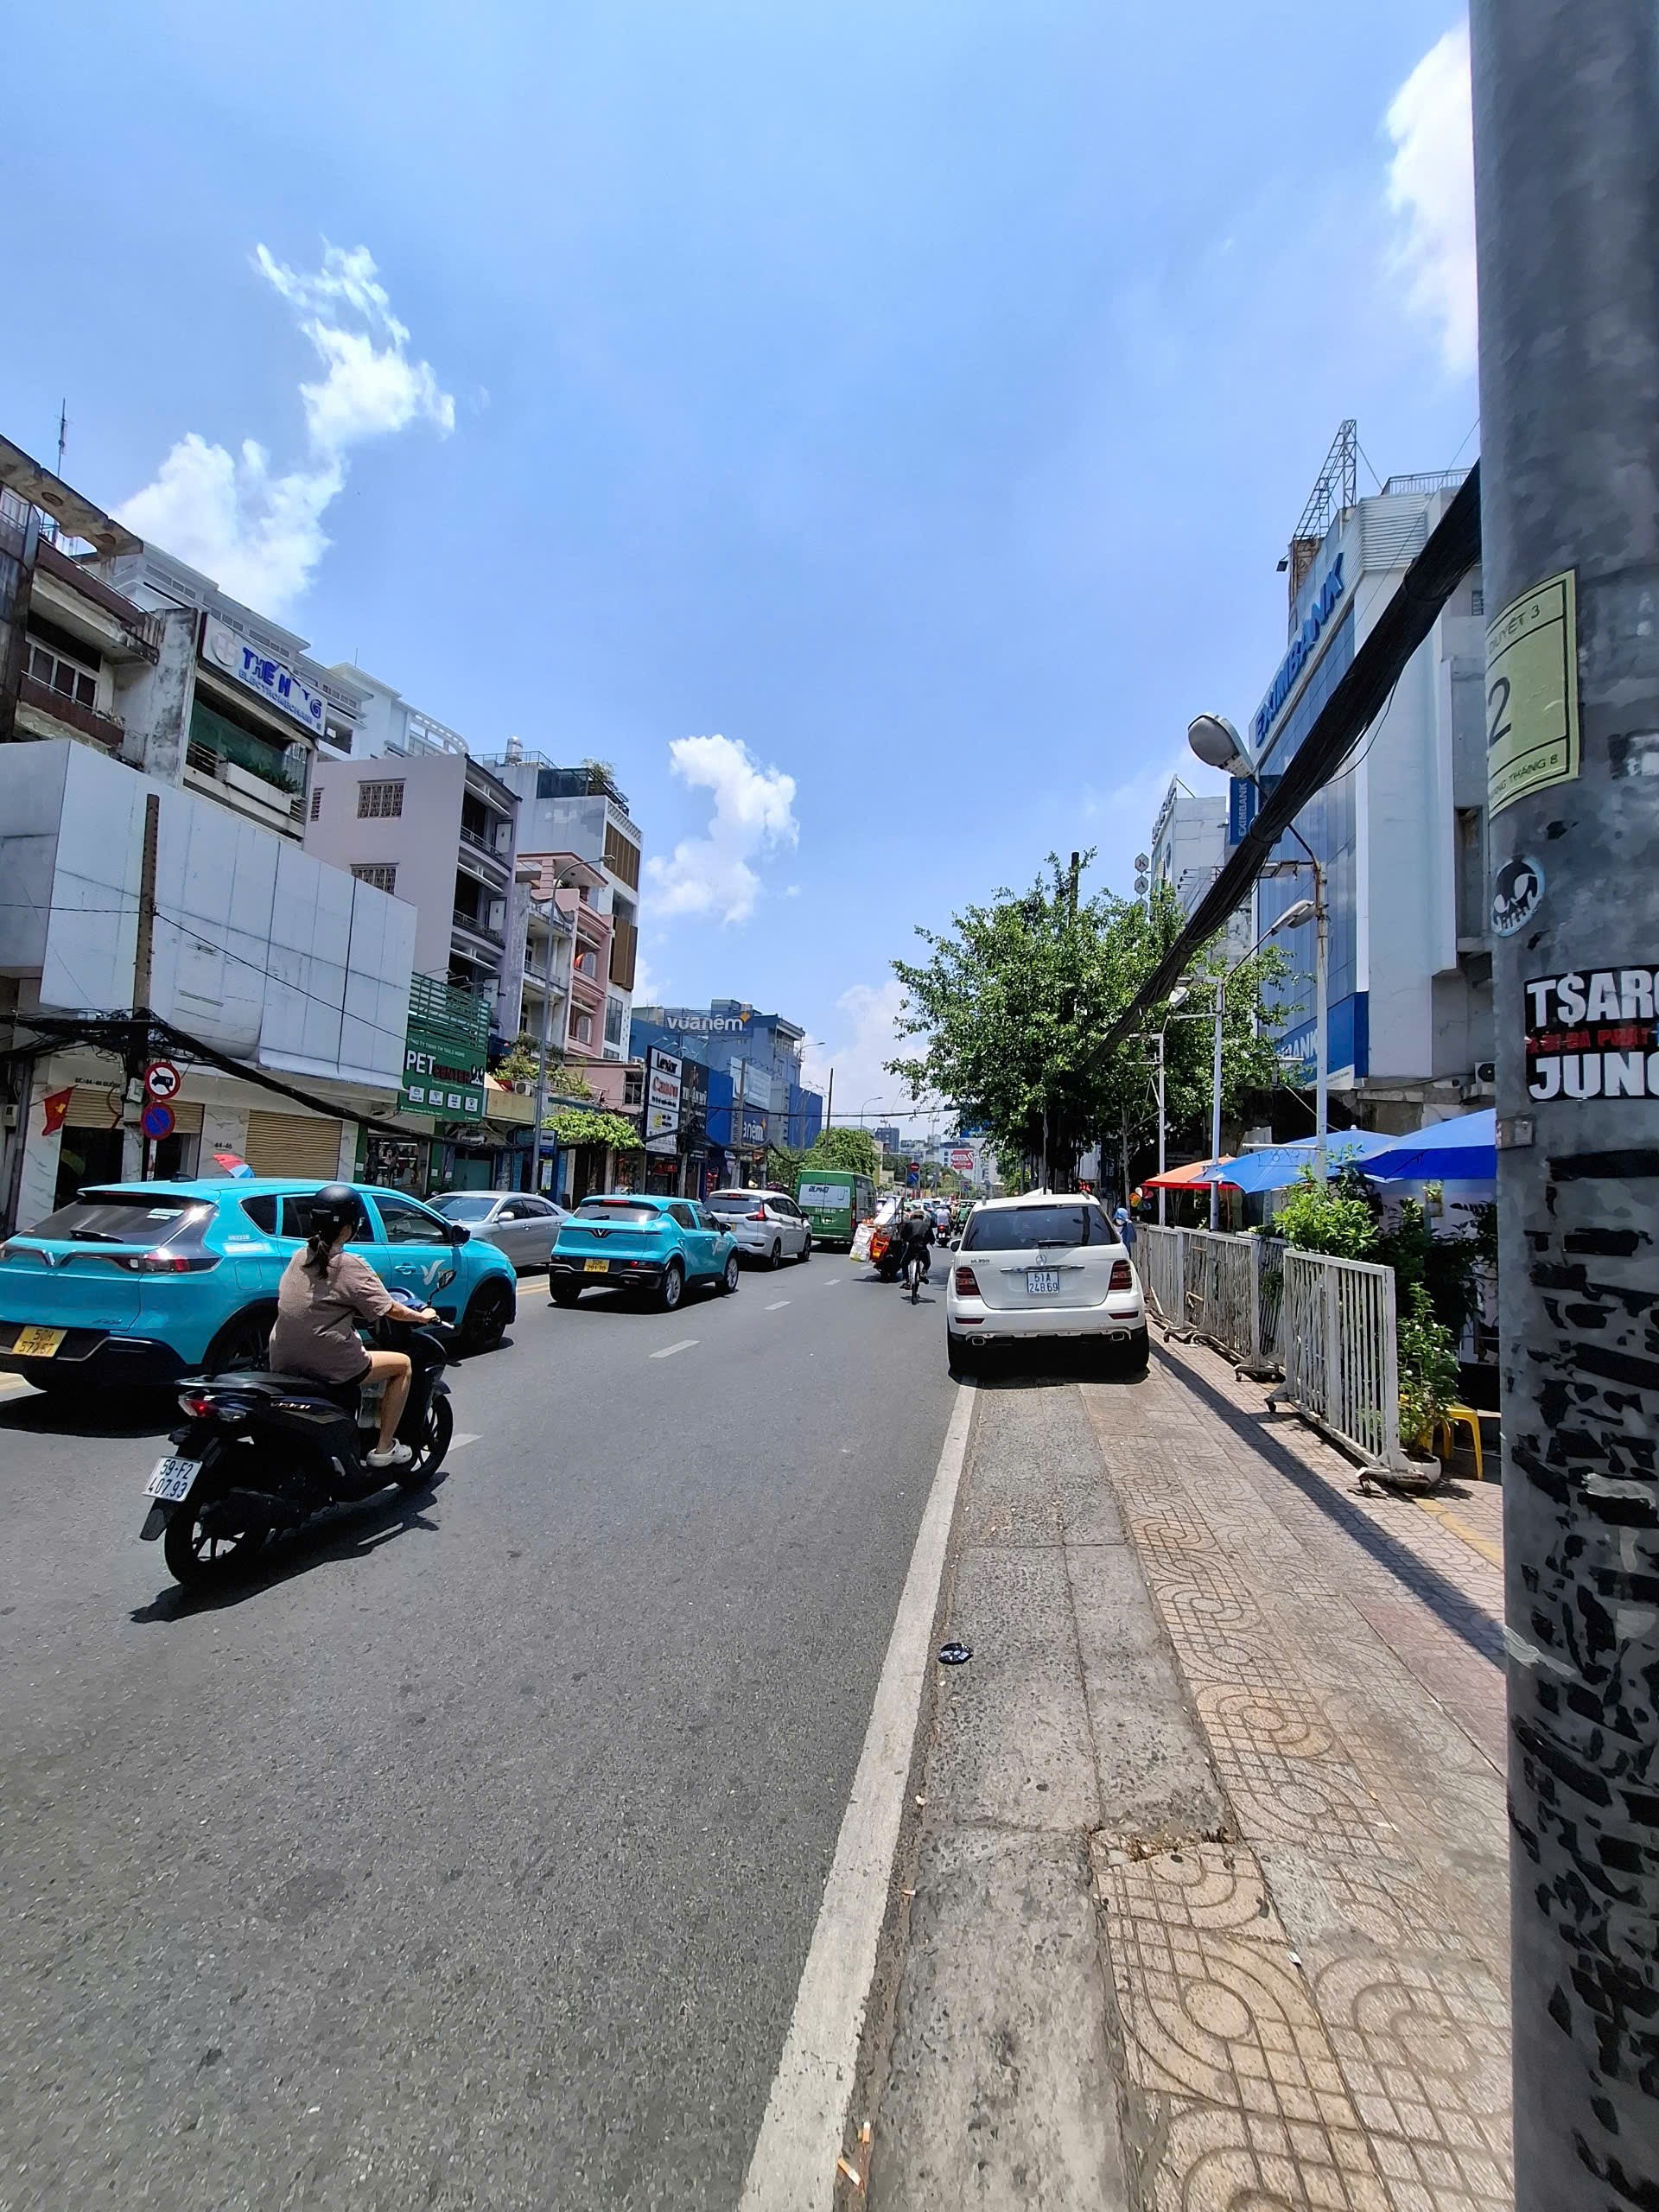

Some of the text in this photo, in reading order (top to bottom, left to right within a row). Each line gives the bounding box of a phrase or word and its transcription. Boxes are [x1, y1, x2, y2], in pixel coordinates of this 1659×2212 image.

[1531, 604, 1541, 619] 3
[1549, 753, 1559, 766] 8
[1237, 782, 1248, 837] EXIMBANK
[1527, 969, 1659, 1028] T$AR
[406, 1049, 436, 1075] PET
[1029, 1282, 1058, 1293] 248.69
[1034, 1273, 1052, 1282] 51A
[159, 1459, 194, 1480] 59-F2
[148, 1476, 188, 1498] 407.93
